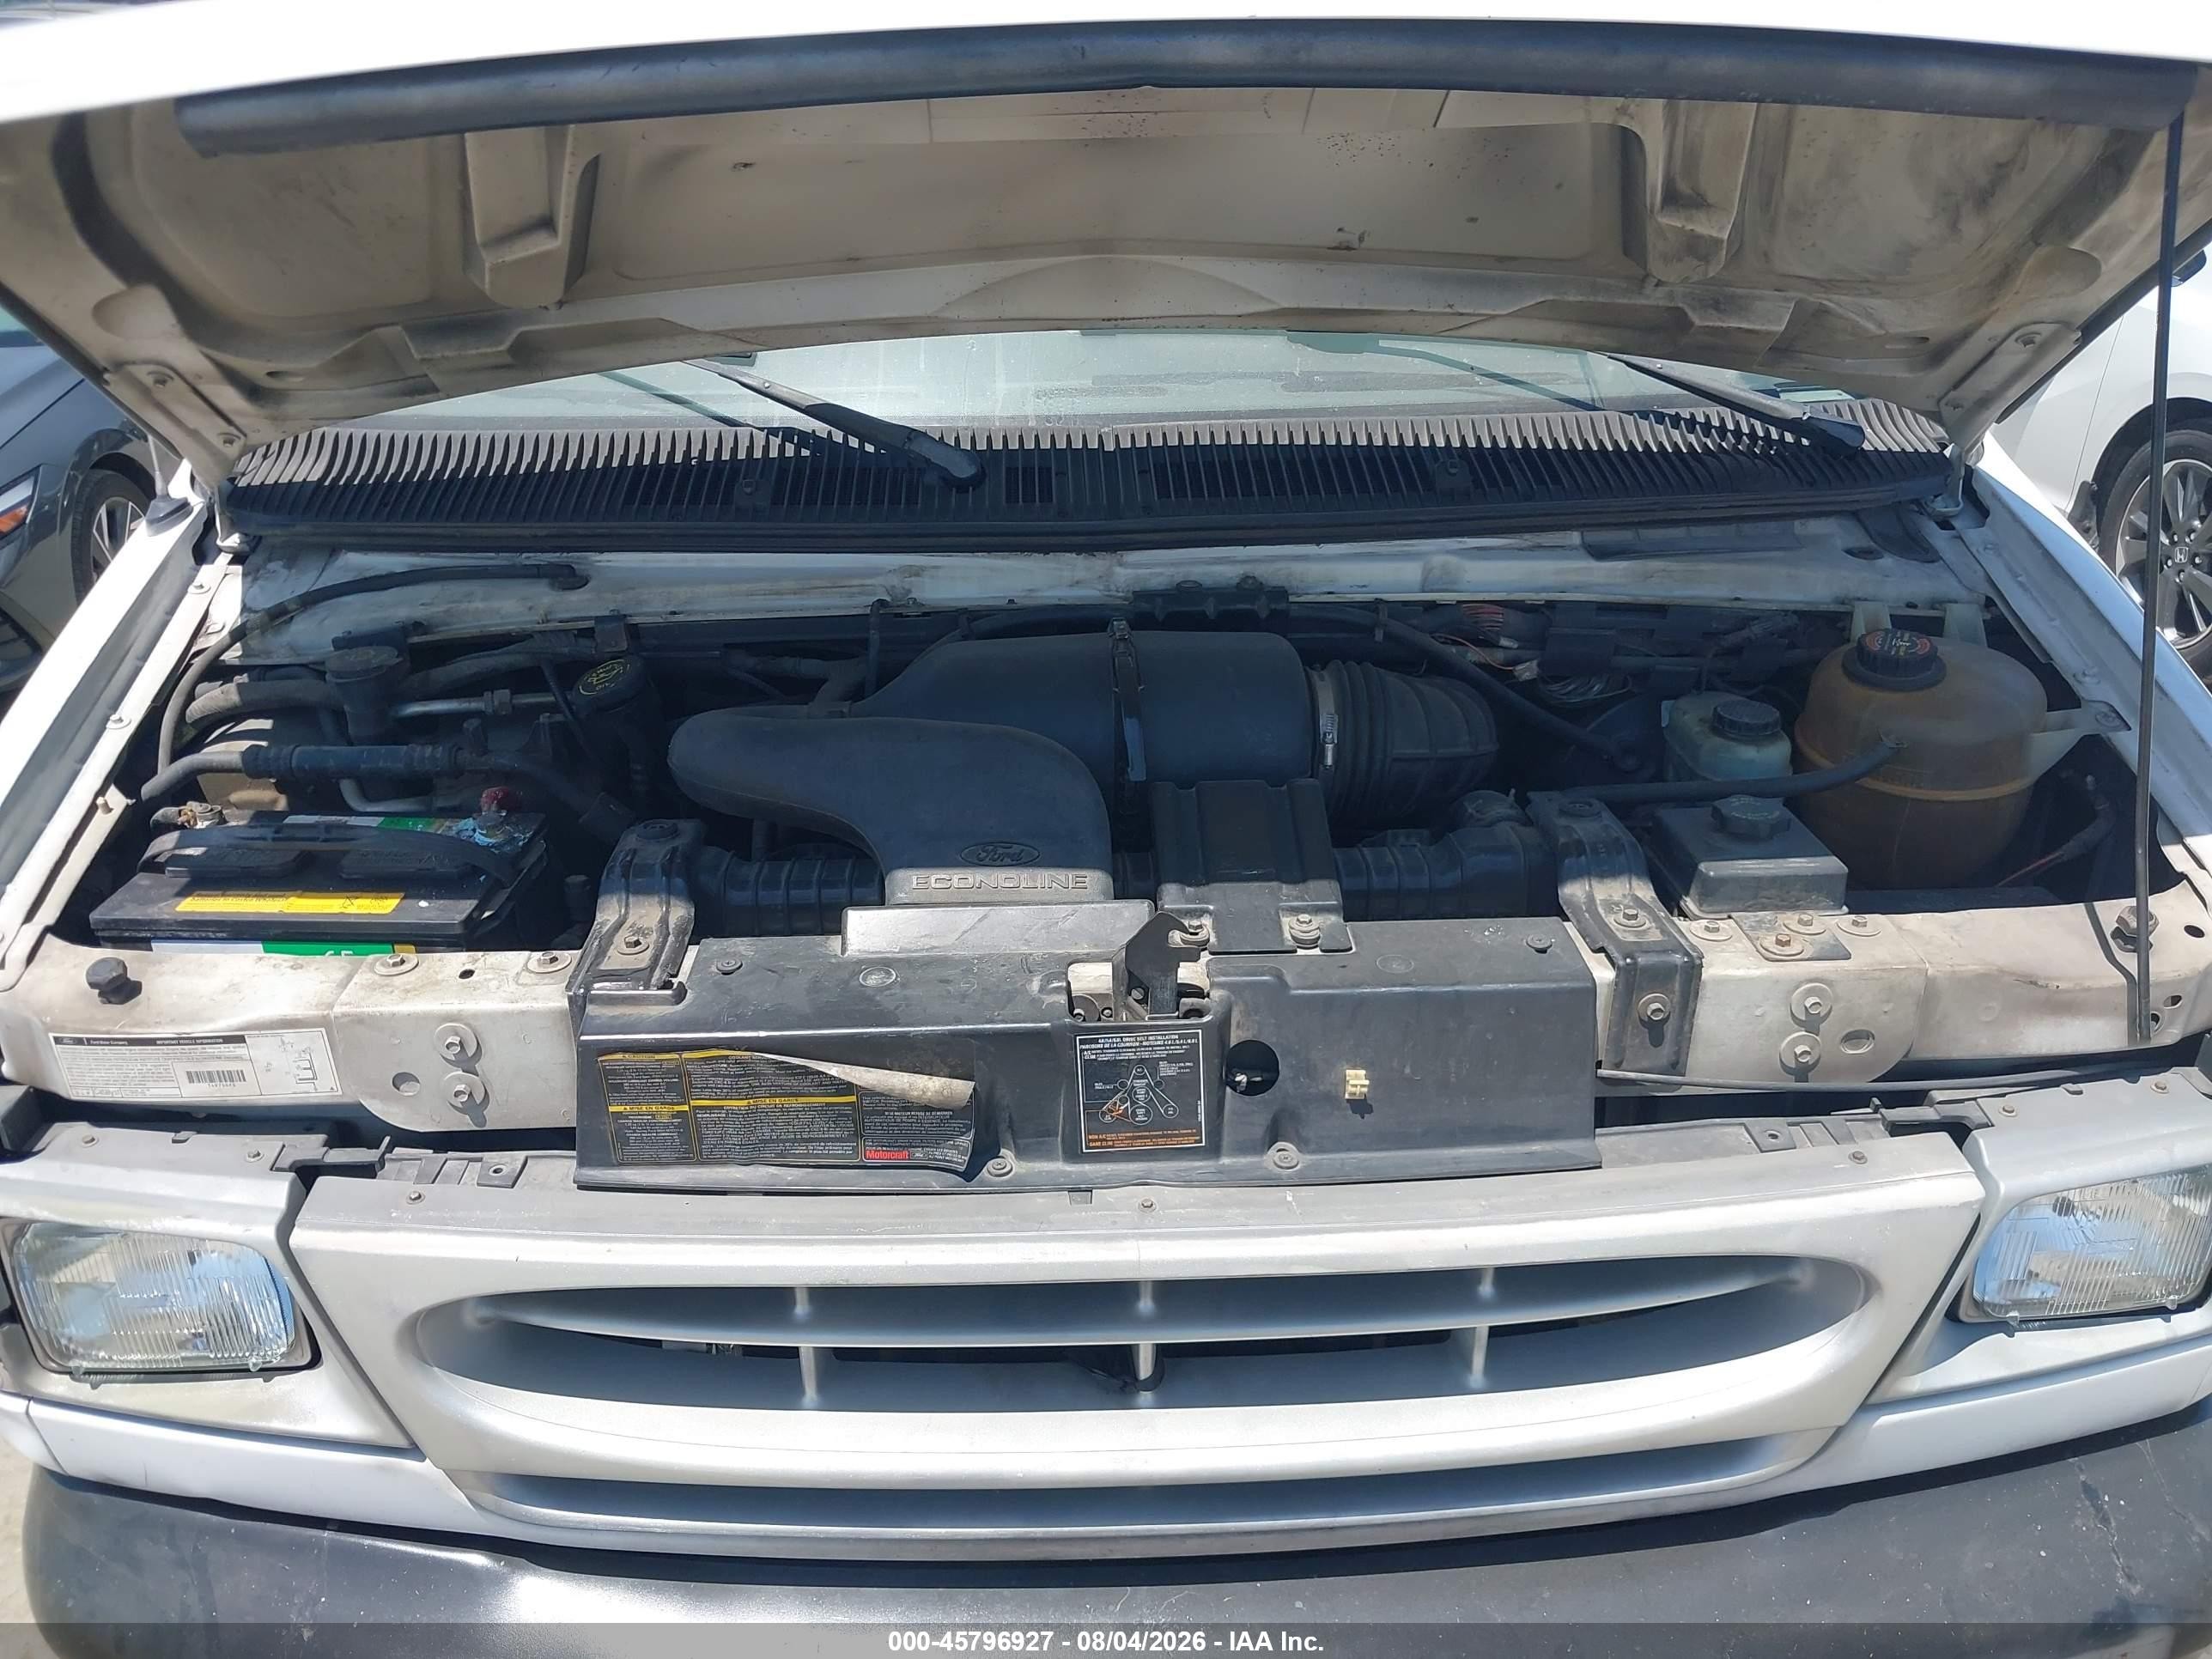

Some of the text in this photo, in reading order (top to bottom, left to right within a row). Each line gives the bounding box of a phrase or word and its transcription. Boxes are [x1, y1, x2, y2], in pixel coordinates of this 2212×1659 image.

[975, 844, 1022, 863] Ford
[912, 874, 1088, 890] ECONOLINE
[866, 1150, 908, 1159] Motorcraft
